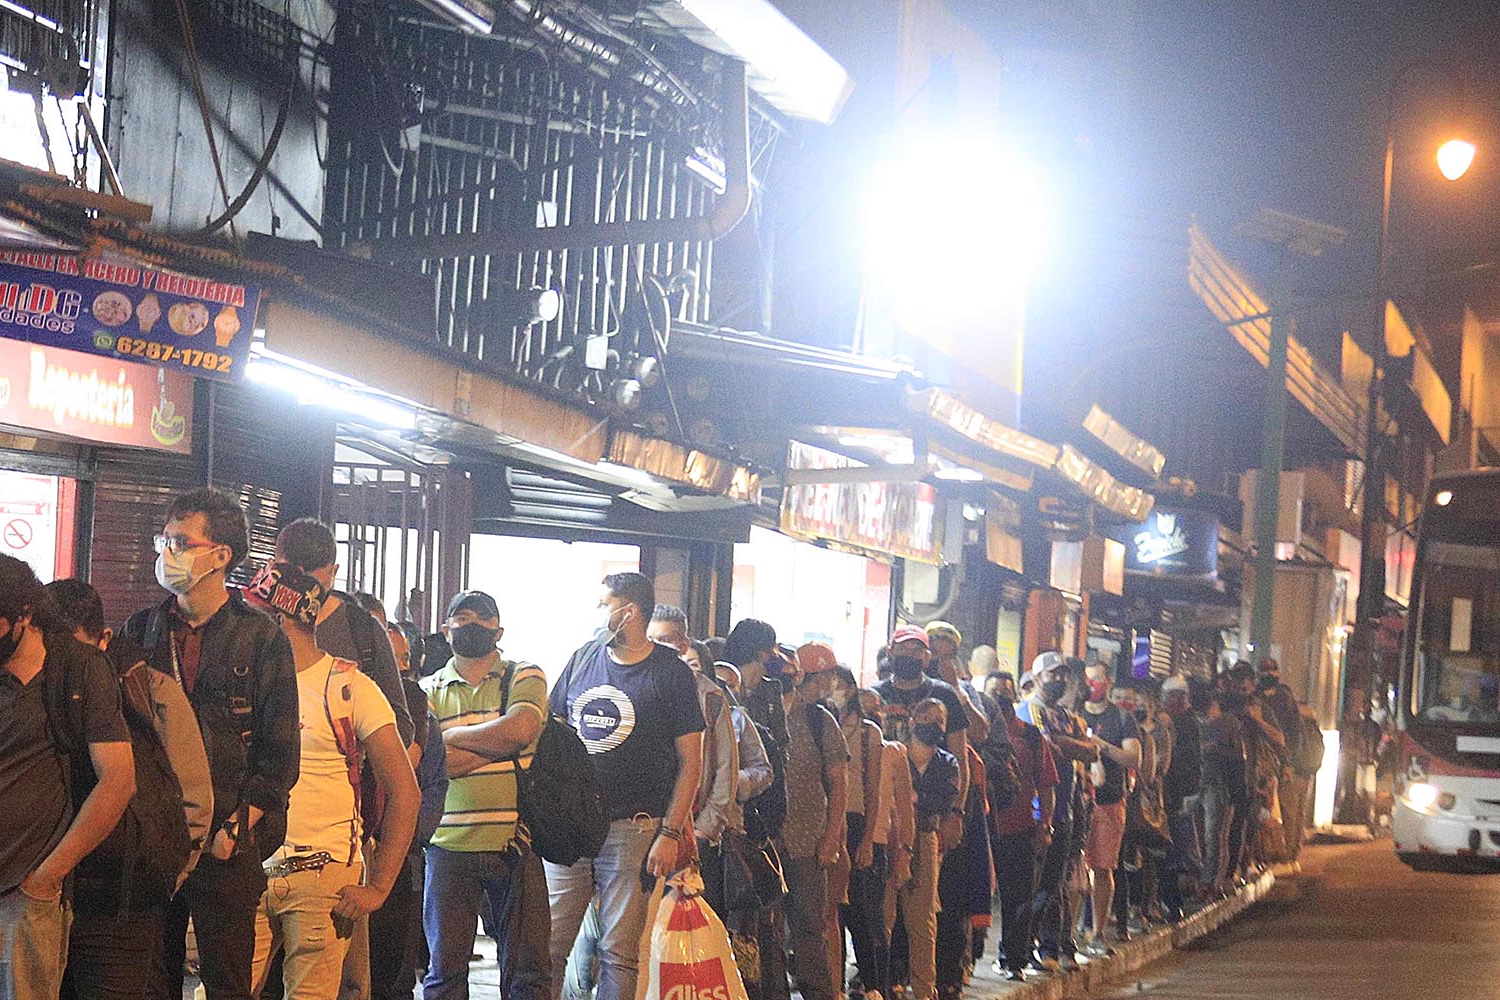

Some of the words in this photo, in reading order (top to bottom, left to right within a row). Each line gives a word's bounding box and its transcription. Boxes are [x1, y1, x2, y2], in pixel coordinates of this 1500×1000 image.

[55, 254, 79, 276] EN
[83, 258, 141, 287] ACERO
[142, 270, 156, 289] Y
[29, 282, 82, 320] DG
[116, 336, 233, 373] 6287-1792
